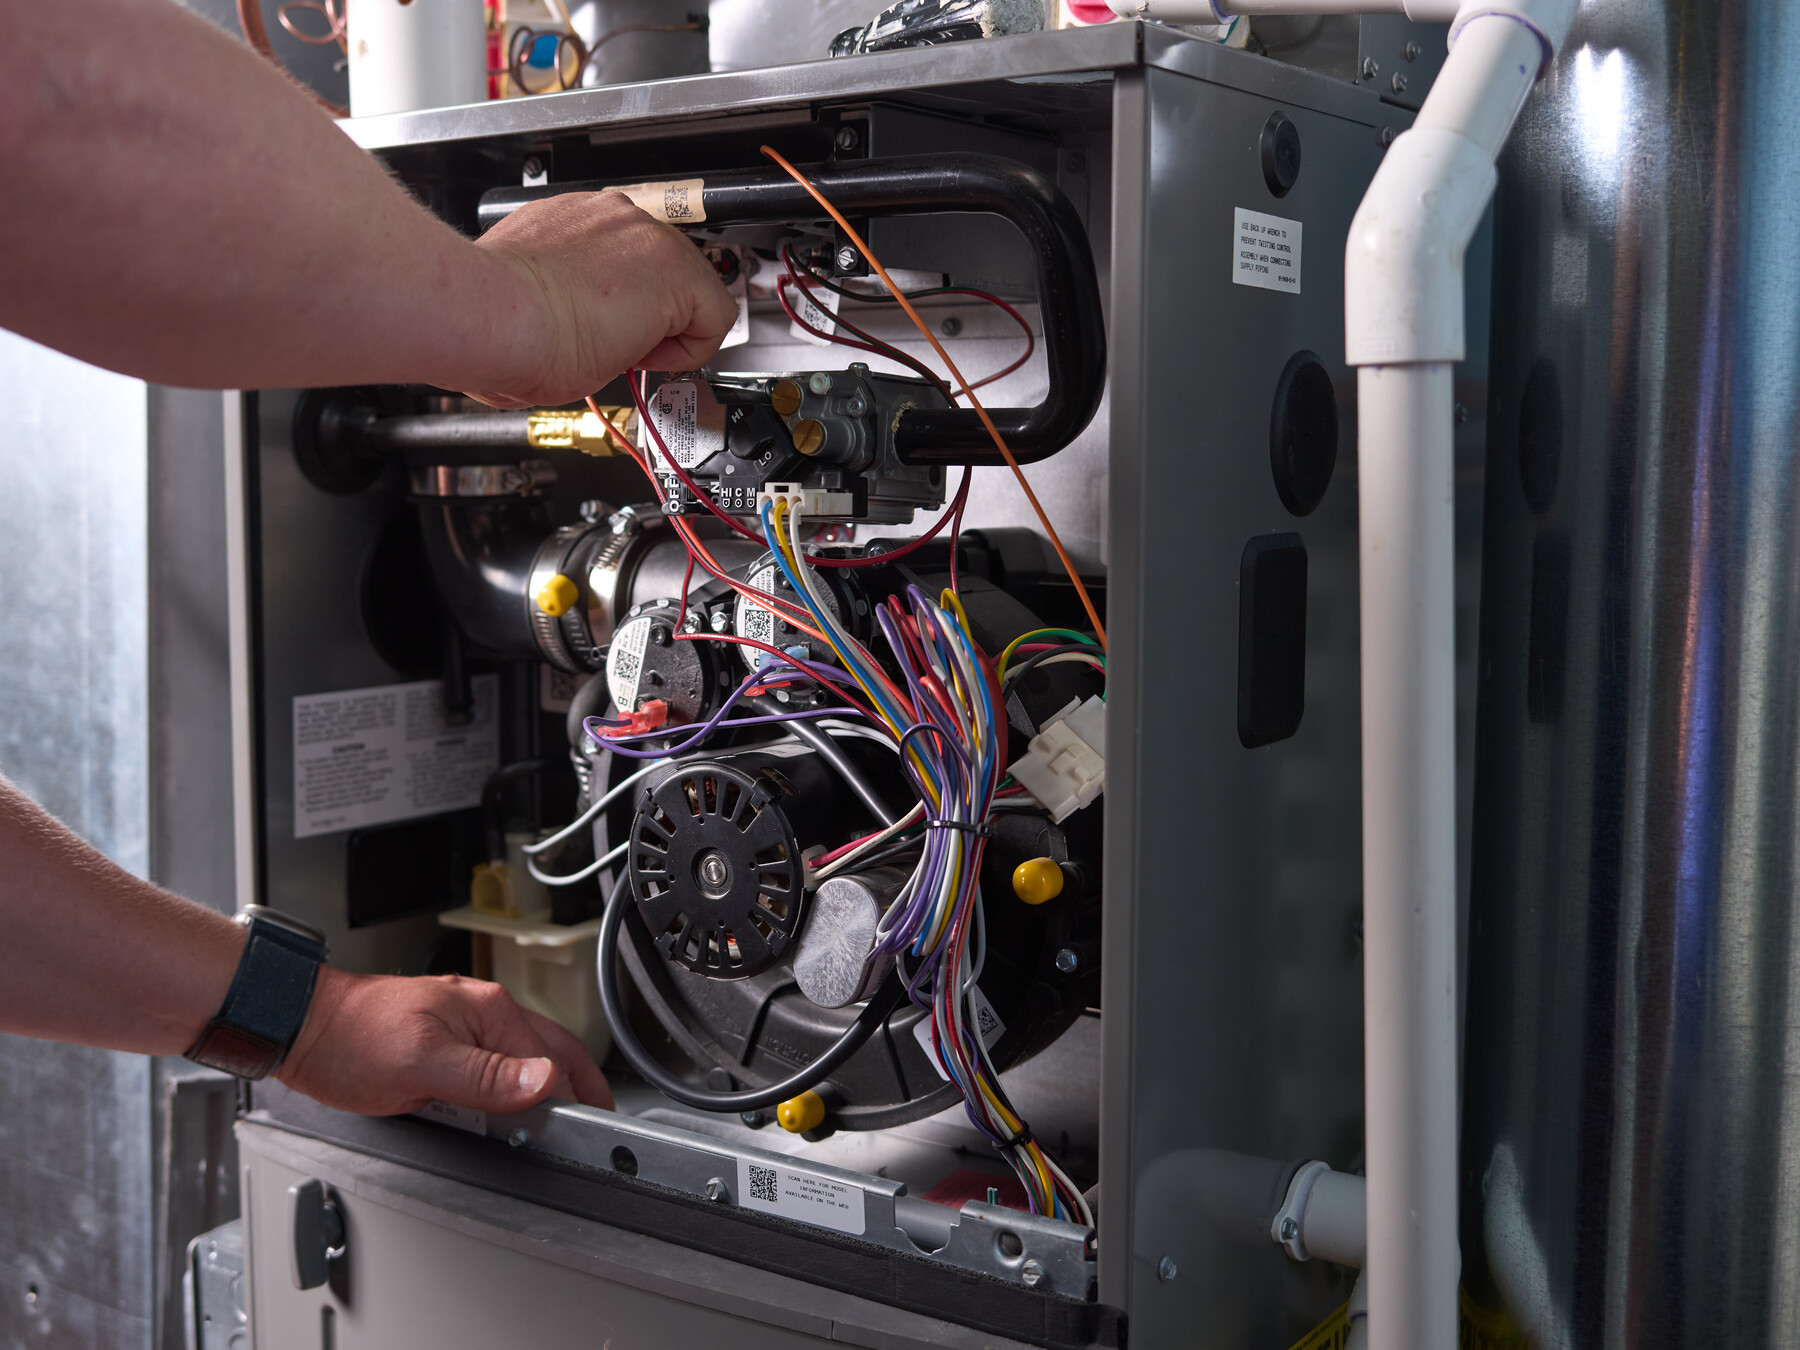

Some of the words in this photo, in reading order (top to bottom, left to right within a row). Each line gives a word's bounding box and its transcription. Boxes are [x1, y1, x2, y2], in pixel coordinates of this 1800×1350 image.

[1241, 222, 1249, 230] USE
[1250, 224, 1260, 232] BACK
[1267, 228, 1281, 237] WRENCH
[1241, 236, 1257, 246] PREVENT
[1258, 239, 1276, 250] TWISTING
[1277, 244, 1292, 253] CONTROL
[1240, 251, 1258, 261] ASSEMBLY
[1259, 254, 1269, 262] WHEN
[1270, 257, 1292, 267] CONNECTING
[1240, 262, 1254, 271] SUPPLY
[1255, 265, 1269, 273] PIPING
[731, 408, 744, 423] HI
[758, 451, 772, 466] LO
[669, 478, 680, 513] OFF
[721, 487, 732, 497] HI
[735, 487, 743, 497] C
[746, 487, 756, 497] M
[617, 695, 629, 707] B
[800, 1186, 835, 1198] INFORMATION
[803, 1178, 816, 1186] HERE
[818, 1182, 830, 1190] FOR
[831, 1185, 848, 1193] MODEL
[785, 1190, 813, 1202] AVAILABLE
[838, 1202, 850, 1210] WEB
